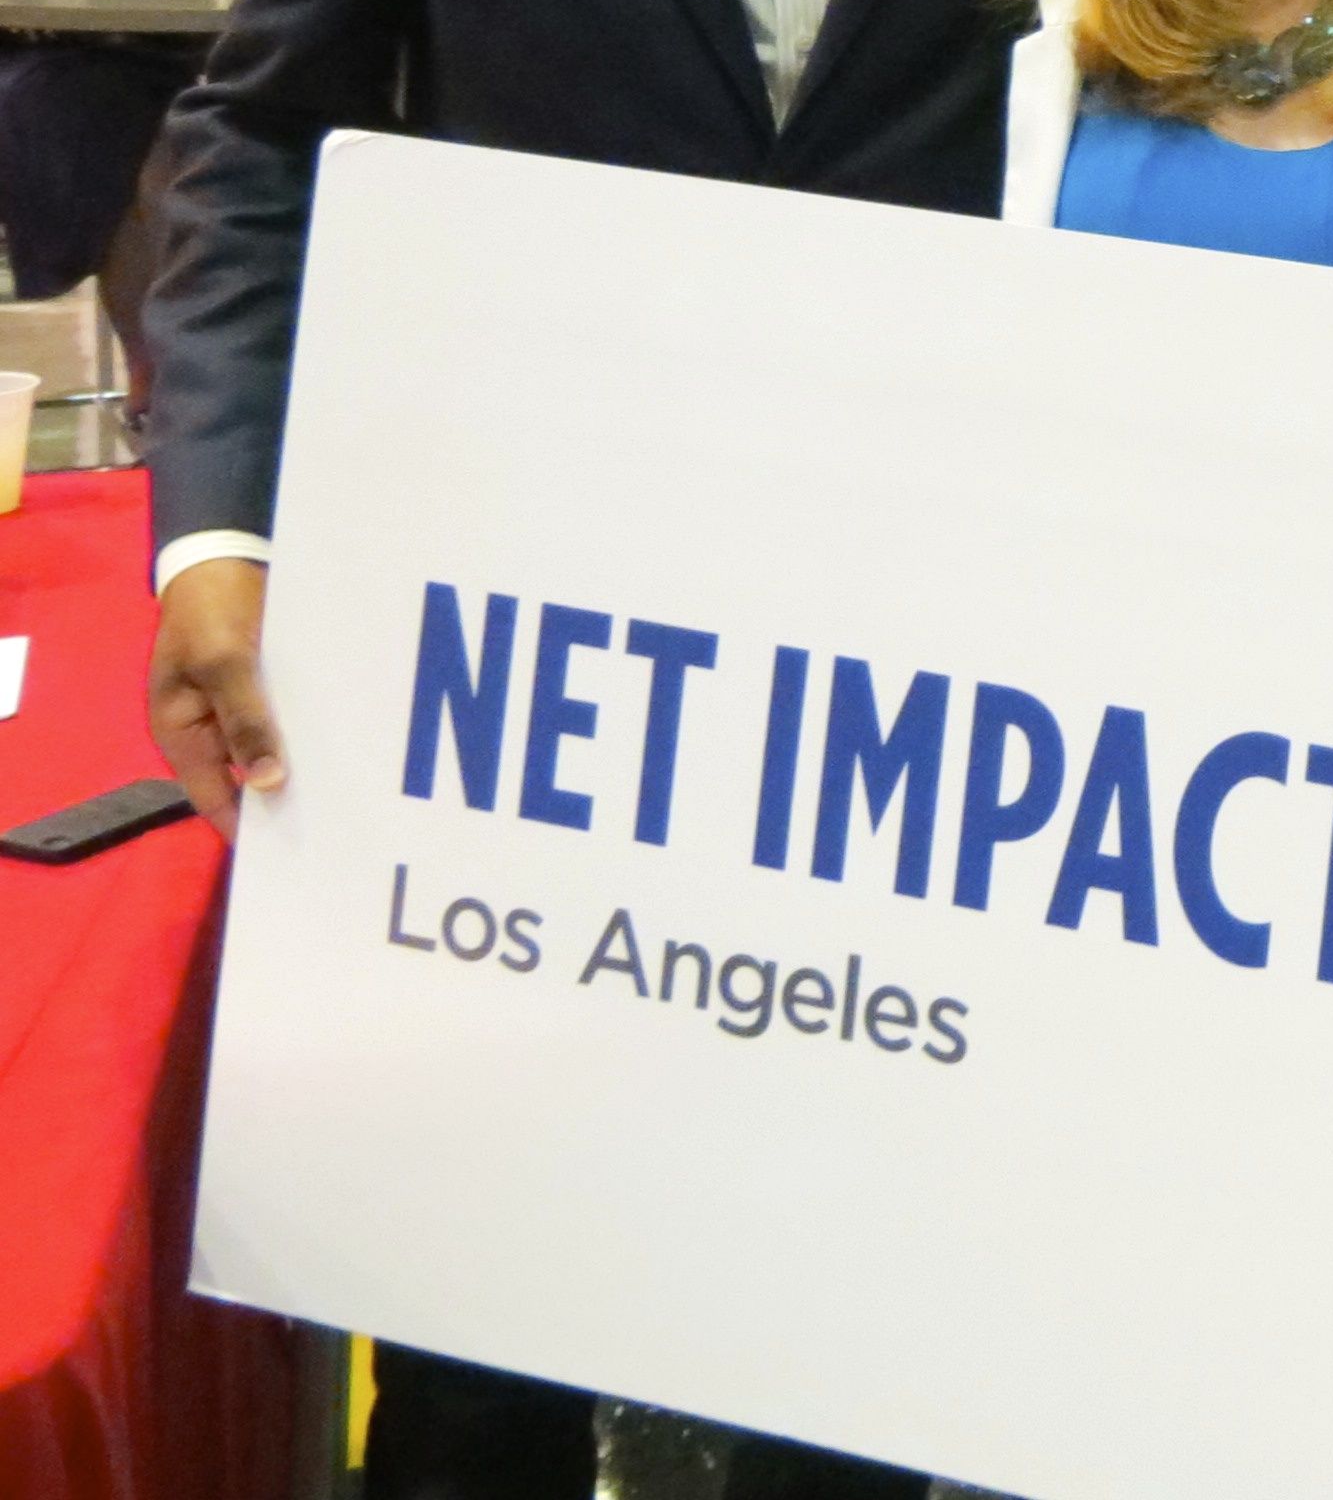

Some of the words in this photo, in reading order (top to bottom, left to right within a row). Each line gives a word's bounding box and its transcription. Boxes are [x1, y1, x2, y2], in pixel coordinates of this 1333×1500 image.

[401, 581, 719, 847] NET
[387, 863, 543, 974] Los
[577, 907, 969, 1065] Angeles
